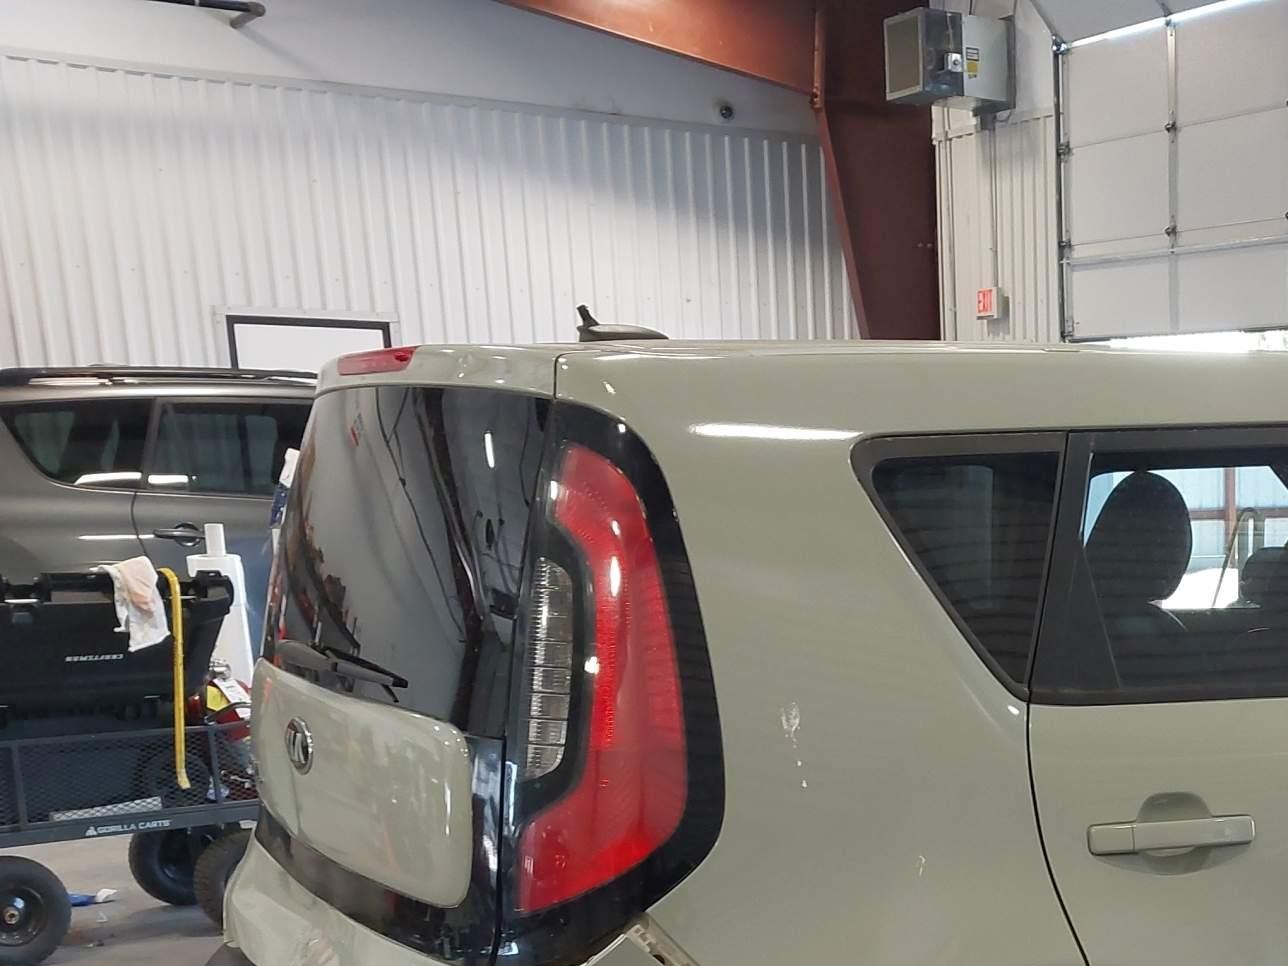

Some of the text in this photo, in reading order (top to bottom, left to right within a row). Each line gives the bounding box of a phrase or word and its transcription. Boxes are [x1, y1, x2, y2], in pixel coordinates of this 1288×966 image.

[977, 289, 993, 313] EXIT
[97, 820, 170, 834] GORILLA CARTS
